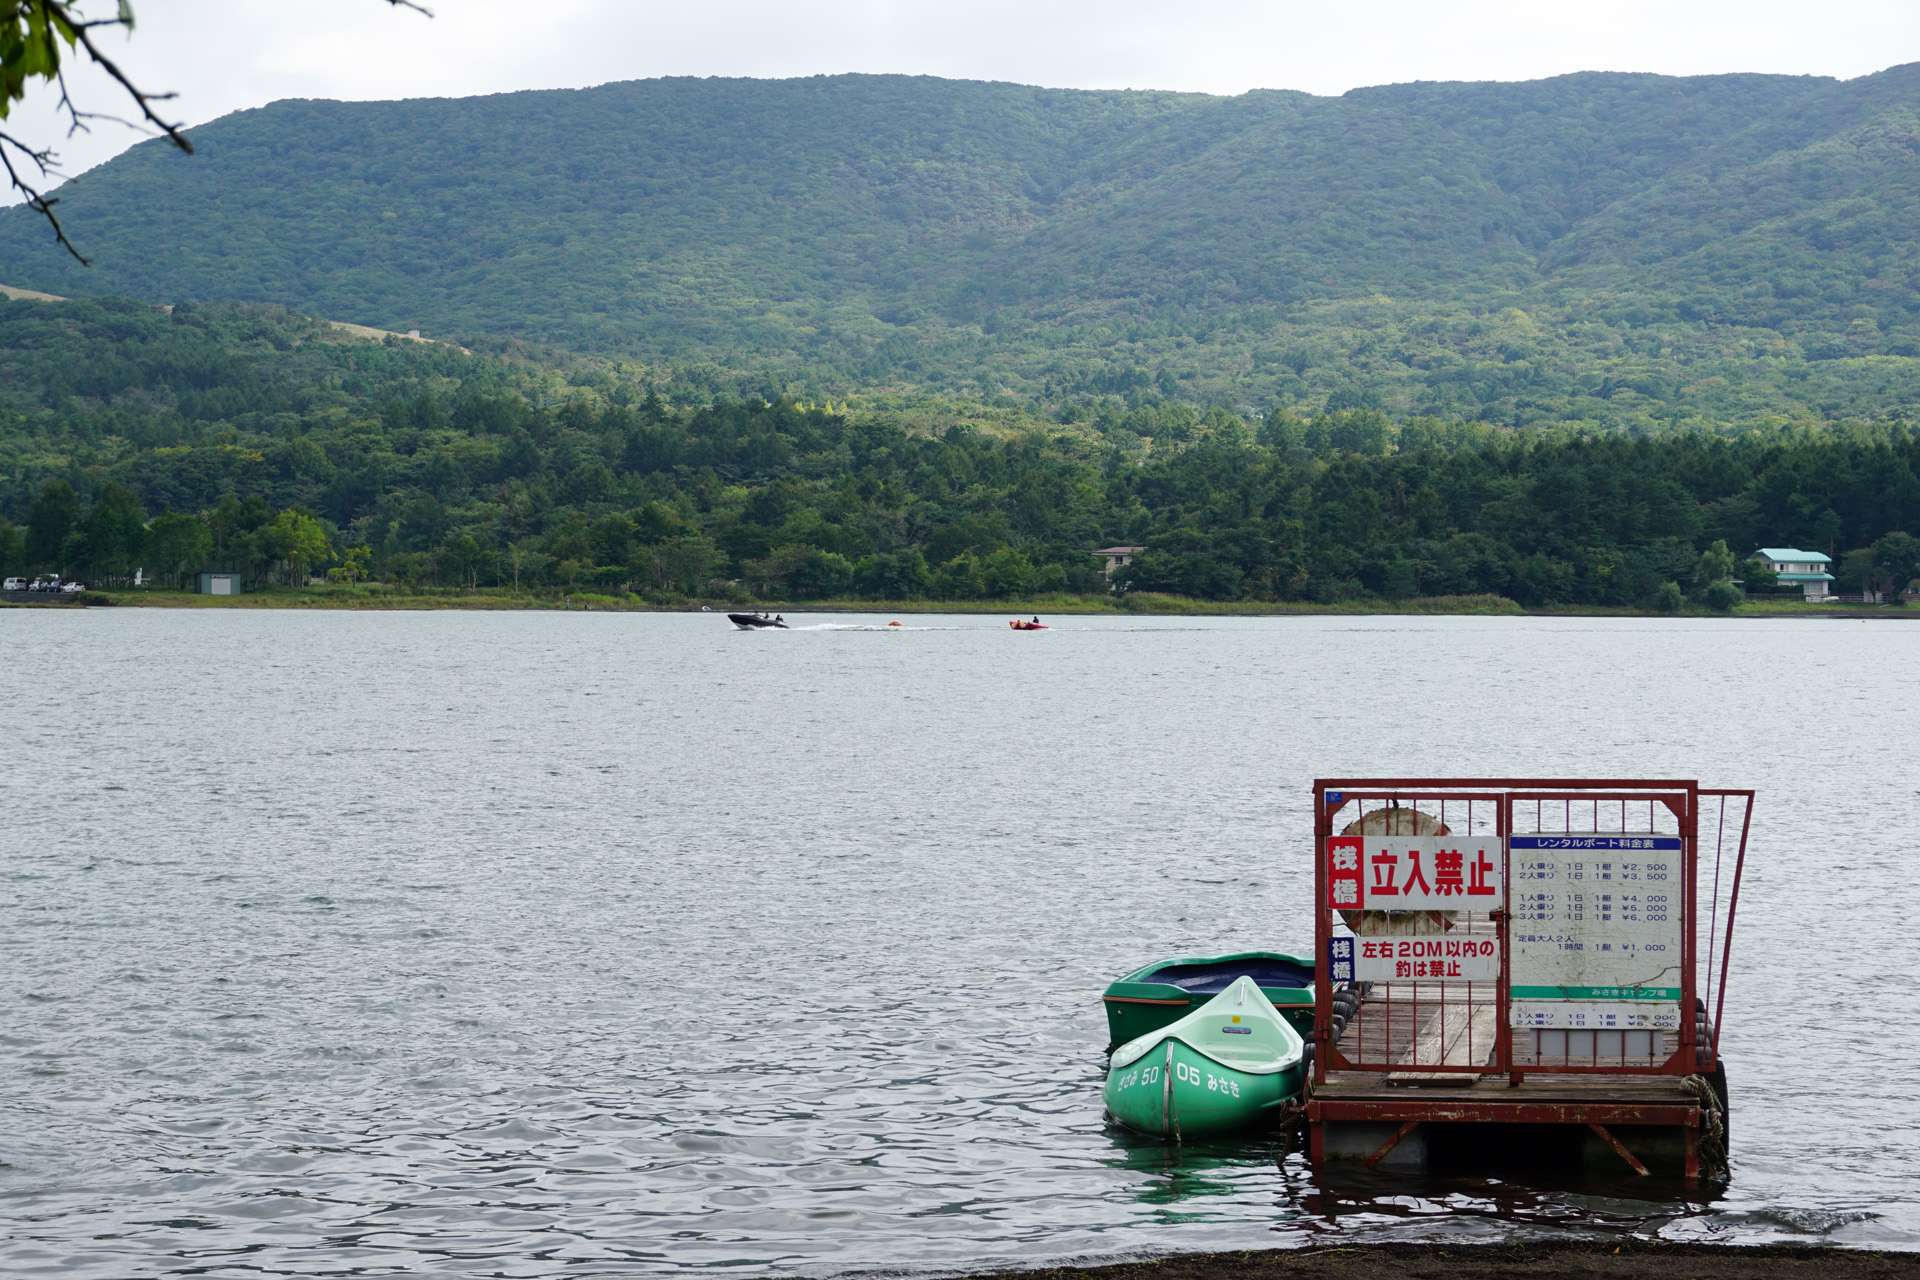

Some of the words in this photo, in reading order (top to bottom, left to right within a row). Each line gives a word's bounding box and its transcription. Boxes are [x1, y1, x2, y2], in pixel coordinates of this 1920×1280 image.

[1537, 838, 1655, 849] レンタルボート料金表
[1519, 862, 1555, 870] 1人乗り
[1567, 862, 1583, 870] 1日
[1595, 862, 1612, 870] 1艇
[1332, 845, 1358, 904] 桟橋
[1370, 849, 1496, 897] 立入禁止
[1519, 872, 1555, 880] 2人乗り
[1567, 872, 1583, 880] 1日
[1595, 872, 1612, 880] 1艇
[1519, 894, 1555, 902] 1人乗り
[1567, 894, 1583, 902] 1日
[1595, 894, 1612, 902] 1艇
[1519, 904, 1555, 912] 2人乗り
[1567, 904, 1583, 912] 1日
[1595, 904, 1612, 912] 1艇
[1519, 913, 1555, 921] 3人乗り
[1567, 913, 1583, 921] 1日
[1595, 913, 1612, 921] 1艇
[1517, 934, 1574, 942] 定員大人2人
[1332, 940, 1351, 980] 桟橋
[1395, 960, 1462, 978] 釣は禁止
[1592, 988, 1667, 998] みさきキャンプ場
[1176, 1062, 1200, 1087] 05
[1207, 1073, 1240, 1098] みさき
